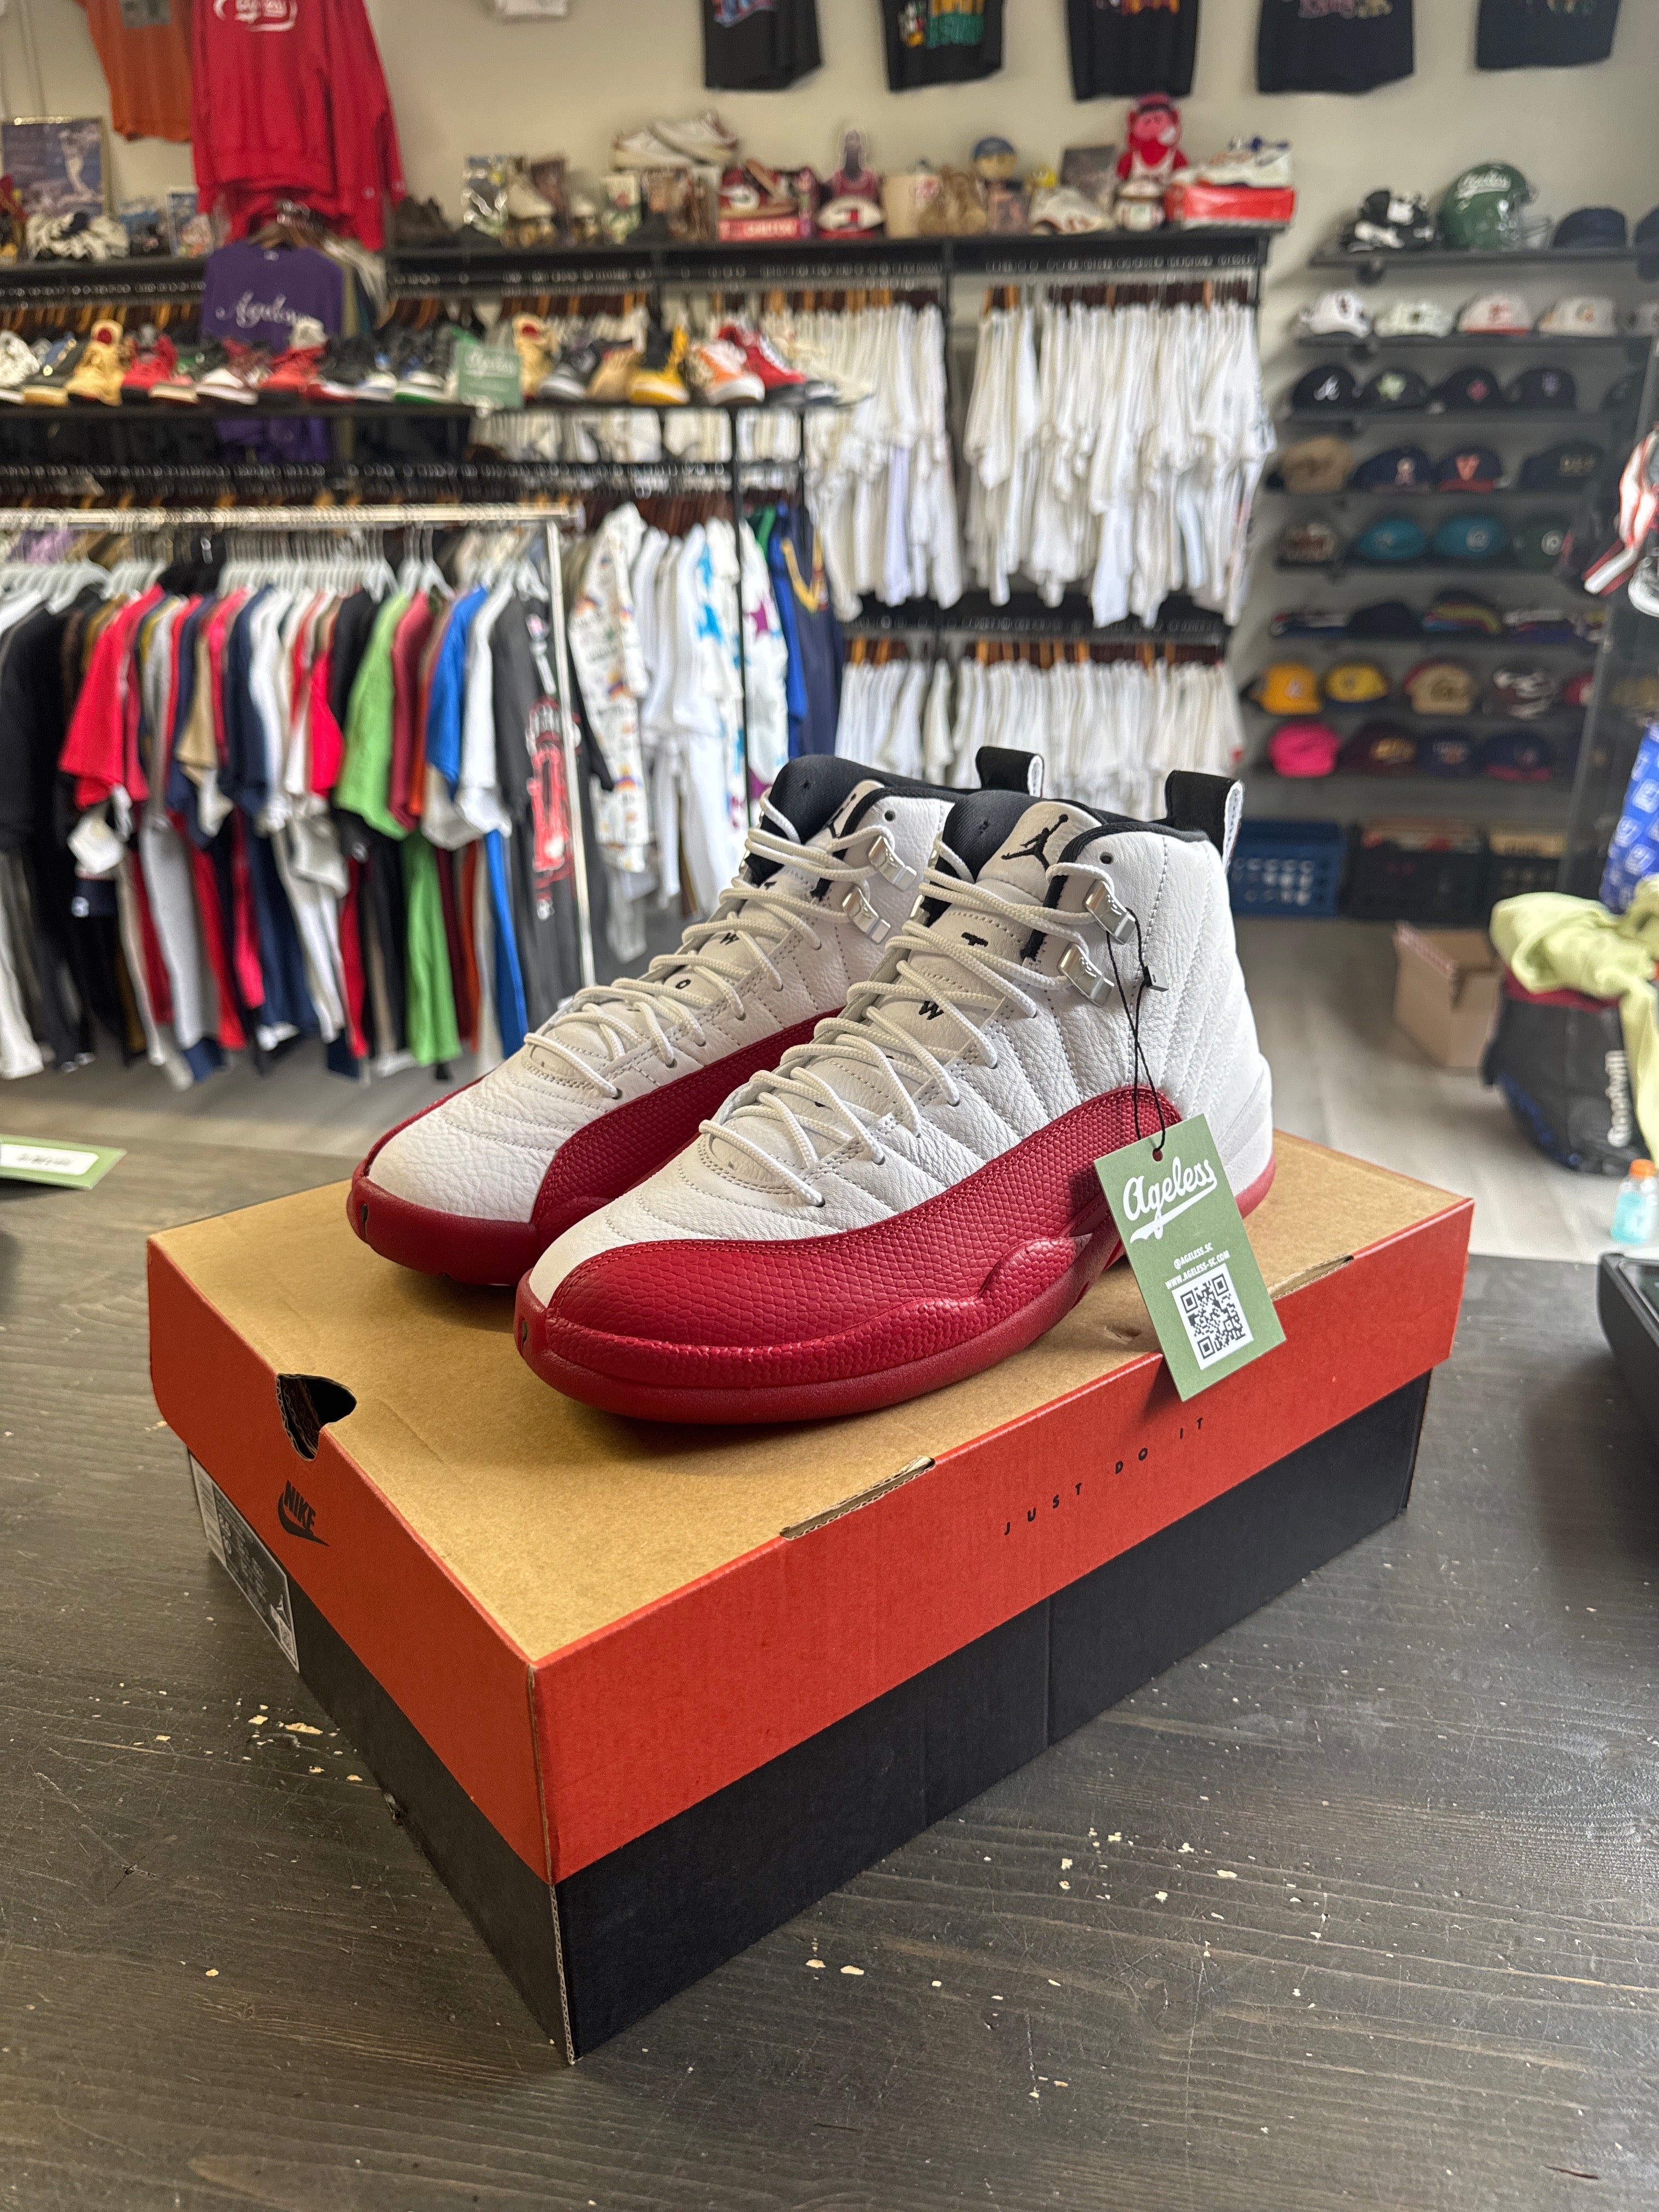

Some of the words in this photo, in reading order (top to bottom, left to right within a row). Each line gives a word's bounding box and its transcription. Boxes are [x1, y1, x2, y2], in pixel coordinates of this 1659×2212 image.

[1123, 1156, 1217, 1241] Ageless
[1165, 1250, 1230, 1290] WWW.AGELESS-SC.COM
[1173, 1242, 1213, 1269] @AGELESS.SC
[1005, 1482, 1082, 1536] JUST
[1115, 1447, 1148, 1475] DO
[1180, 1417, 1203, 1440] IT
[284, 1479, 316, 1535] NIKE
